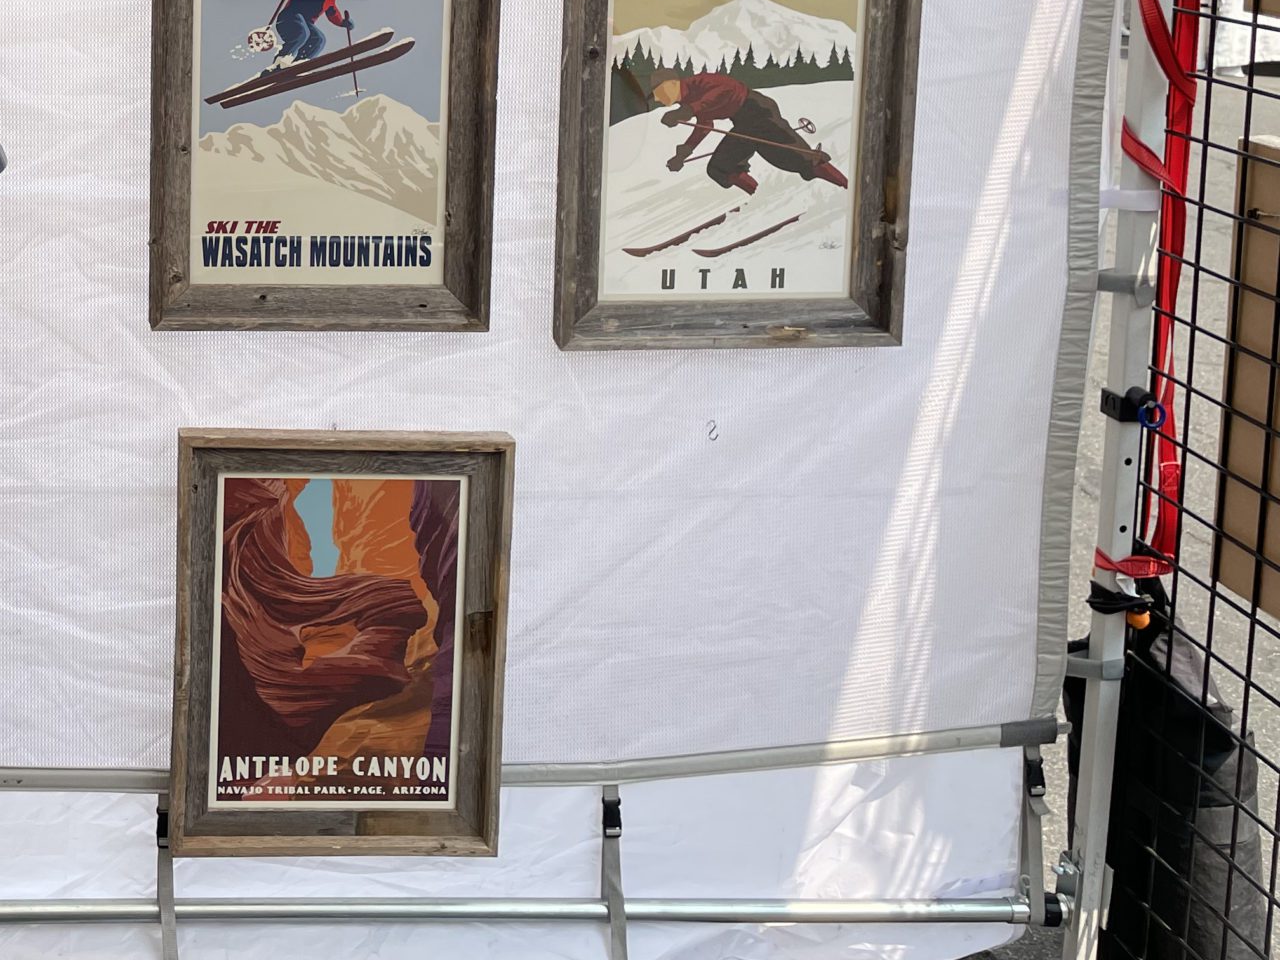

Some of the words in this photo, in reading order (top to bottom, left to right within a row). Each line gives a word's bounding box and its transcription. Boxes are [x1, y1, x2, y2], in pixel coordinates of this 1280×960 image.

[205, 220, 239, 234] SKI
[244, 220, 281, 234] THE
[201, 235, 302, 268] WASATCH
[309, 235, 432, 268] MOUNTAINS
[661, 268, 786, 290] UTAH
[219, 756, 338, 783] ANTELOPE
[352, 756, 447, 783] CANYON
[217, 786, 263, 795] NAVAJO
[267, 786, 310, 795] TRIBAL
[392, 786, 447, 795] ARIZONA
